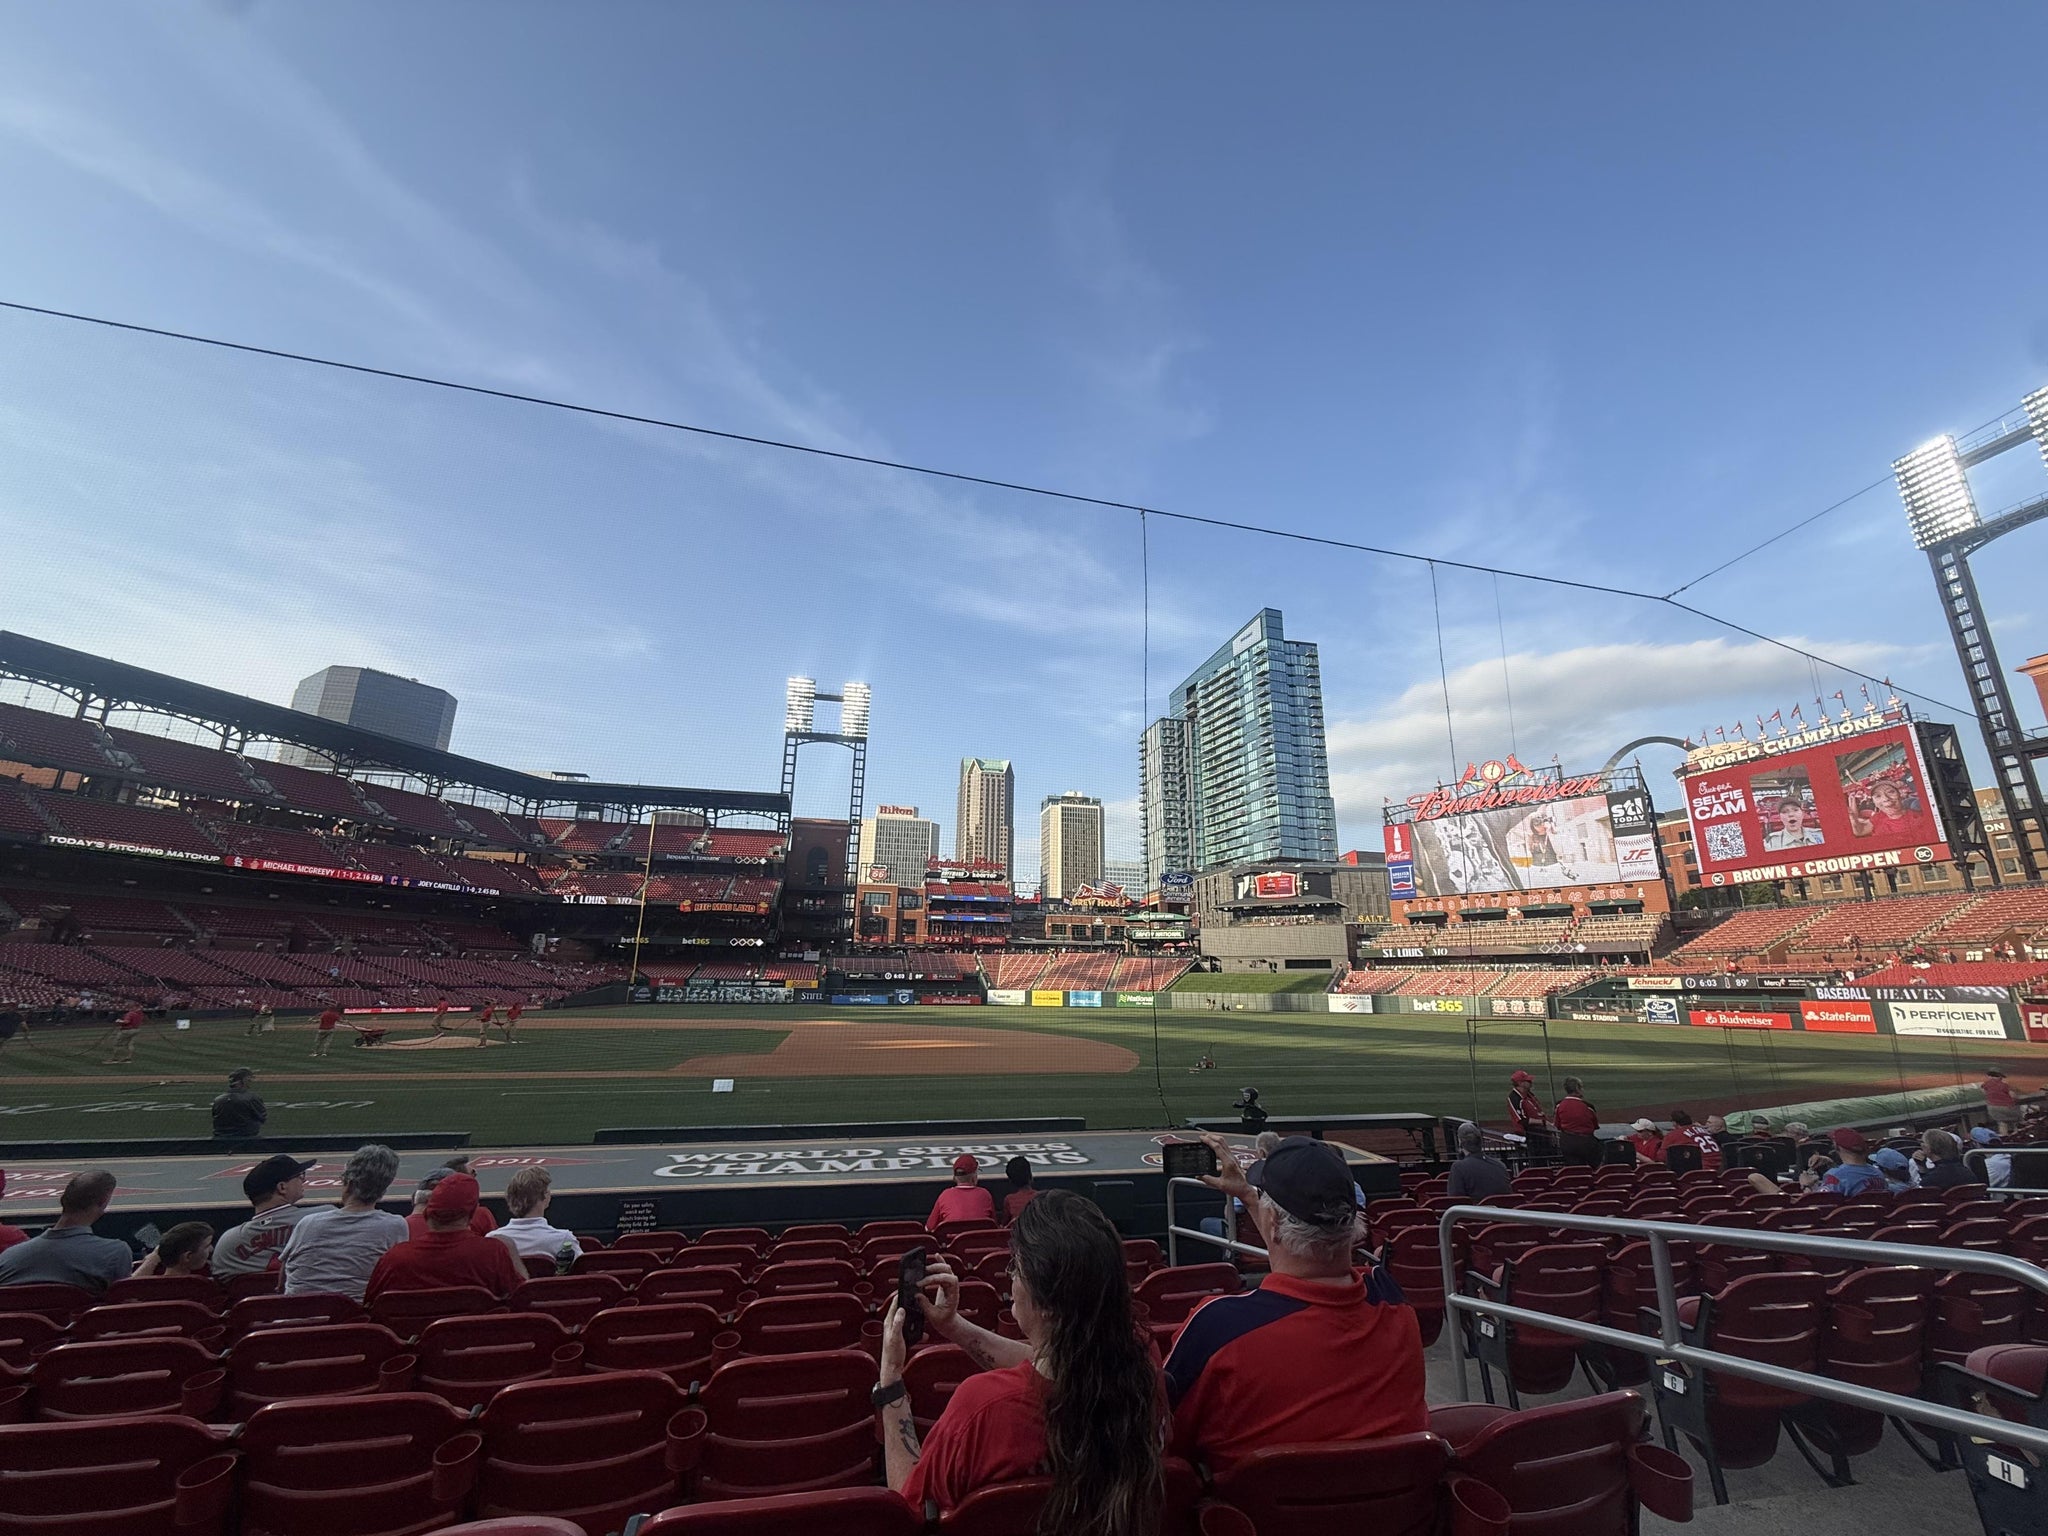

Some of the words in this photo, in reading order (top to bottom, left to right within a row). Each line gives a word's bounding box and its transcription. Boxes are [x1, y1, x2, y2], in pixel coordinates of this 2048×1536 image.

[1699, 745, 1761, 770] WORLD
[1763, 715, 1885, 754] CHAMPIONS
[1407, 775, 1603, 822] Budweiser
[1692, 789, 1744, 807] SELFIE
[880, 805, 913, 815] Hilton
[1695, 798, 1747, 820] CAM
[1614, 815, 1645, 824] TODAY
[49, 835, 105, 849] TODAY'S
[108, 843, 164, 856] PITCHING
[166, 850, 221, 862] MATCHUP
[263, 861, 295, 872] MICHAEL
[297, 865, 335, 877] MCGREEVY
[370, 874, 383, 882] ERA
[1732, 865, 1788, 884] BROWN
[1791, 864, 1802, 876] &
[1805, 851, 1900, 875] CROUPPEN
[418, 880, 433, 888] JOEY
[1167, 874, 1188, 885] Ford
[562, 895, 577, 904] ST.
[579, 895, 607, 905] LOUIS
[1568, 892, 1583, 902] 42
[733, 904, 756, 913] LAND
[1358, 915, 1383, 923] SALT
[620, 936, 650, 944] bet65
[682, 937, 710, 945] bet365
[1383, 948, 1396, 957] ST.
[1397, 948, 1423, 957] LOUIS
[1699, 978, 1717, 988] 6:03
[1816, 987, 1871, 1000] BASEBALL
[1413, 998, 1463, 1012] bet365
[1651, 1001, 1669, 1010] Ford
[1719, 1014, 1773, 1026] Budweiser
[1910, 1010, 1997, 1021] PERFICIENT
[1695, 1136, 1719, 1153] 25
[667, 1148, 883, 1163] WORLD
[897, 1142, 1074, 1157] SERIES
[2001, 1461, 2012, 1482] H
